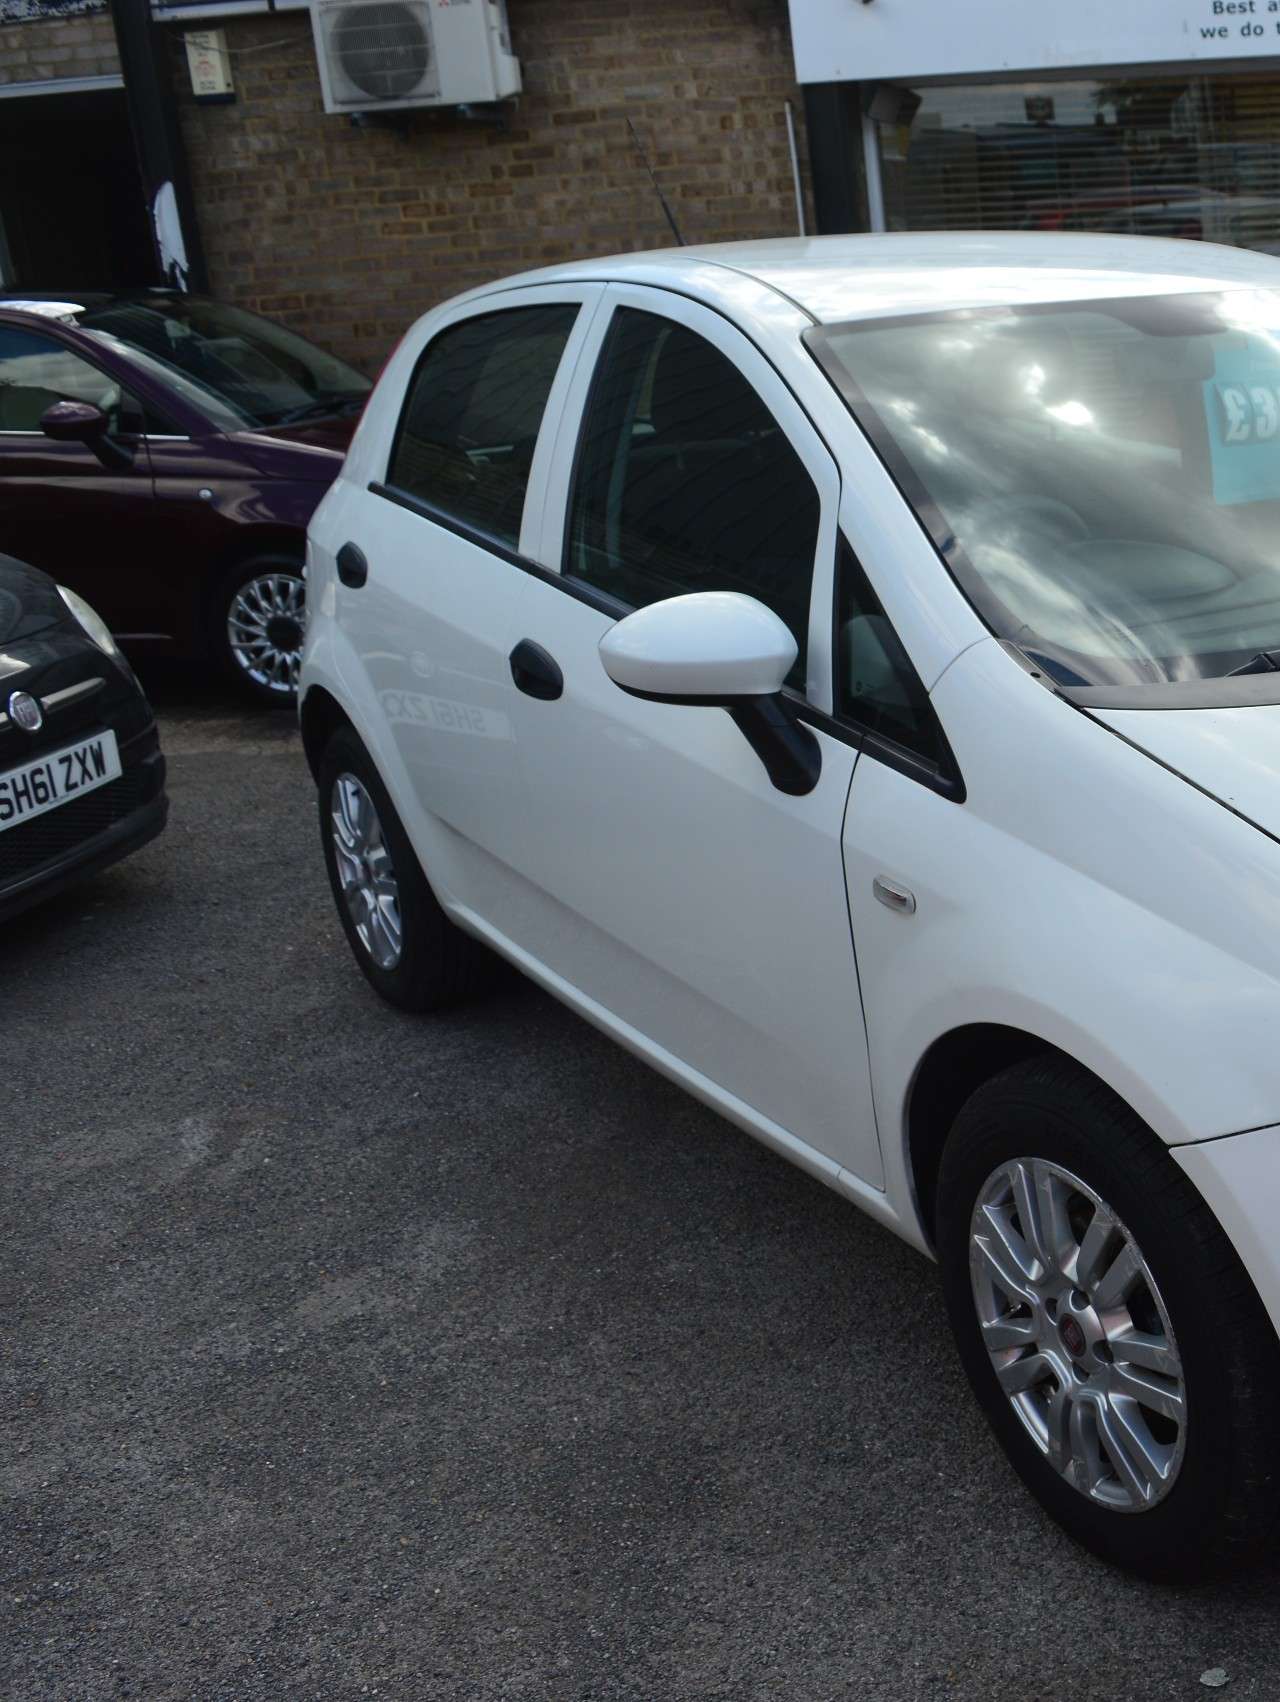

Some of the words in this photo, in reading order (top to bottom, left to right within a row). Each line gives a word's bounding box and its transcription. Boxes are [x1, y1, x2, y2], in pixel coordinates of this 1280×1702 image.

[1213, 0, 1255, 14] Best
[1200, 26, 1228, 38] we
[1241, 22, 1263, 36] do
[0, 764, 57, 820] SH61
[58, 741, 106, 793] ZXW
